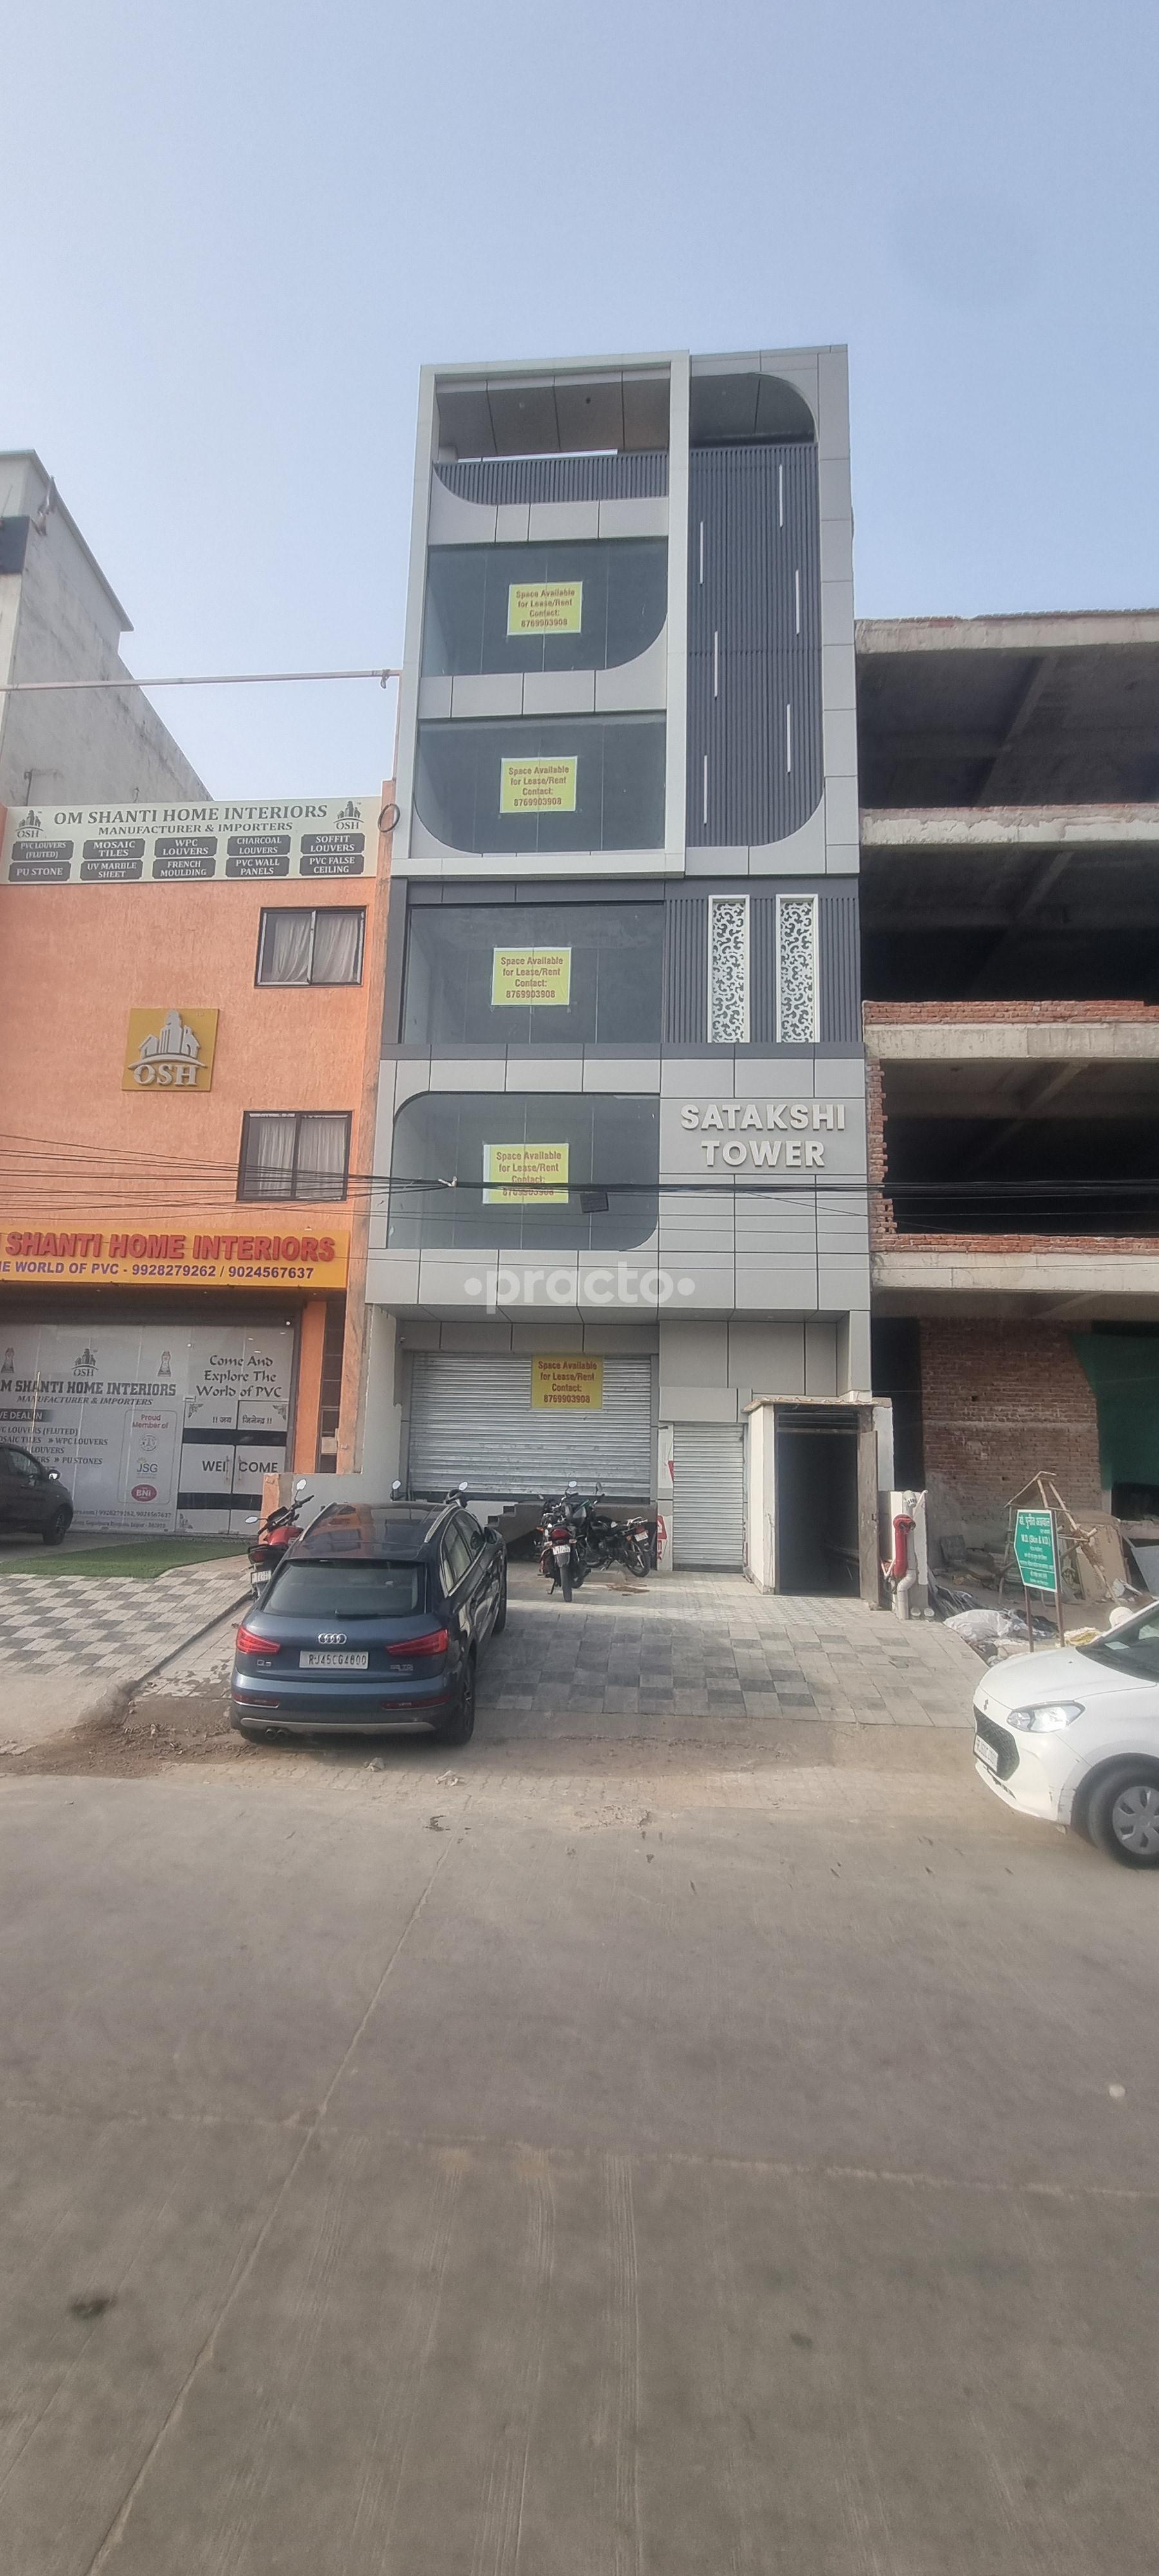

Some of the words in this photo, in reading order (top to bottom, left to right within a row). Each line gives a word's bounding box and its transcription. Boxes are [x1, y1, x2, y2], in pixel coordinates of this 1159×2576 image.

[516, 590, 539, 600] Space
[541, 589, 575, 598] Available
[531, 598, 572, 607] Lease/Rent
[509, 767, 532, 777] Space
[534, 766, 569, 774] Available
[523, 776, 567, 785] Lease/Rent
[54, 811, 83, 825] OM
[88, 809, 158, 824] SHANTI
[162, 808, 220, 822] HOME
[223, 804, 328, 820] INTERIORS
[98, 824, 202, 835] MANUFACTURER
[205, 823, 214, 833] &
[218, 822, 293, 832] IMPORTERS
[335, 821, 359, 830] OSH
[17, 830, 39, 838] OSH
[174, 838, 198, 847] WPC
[236, 837, 282, 845] CHARCOAL
[316, 835, 350, 844] SOFFIT
[93, 840, 136, 849] MOSAIC
[310, 844, 355, 853] LOUVERS
[26, 851, 59, 859] (FLUTED)
[98, 849, 129, 857] TILES
[162, 847, 209, 856] LOUVERS
[167, 860, 201, 869] FRENCH
[236, 858, 253, 867] PVC
[309, 857, 326, 866] PVC
[328, 856, 355, 864] FALSE
[101, 862, 137, 870] MARBLE
[313, 865, 350, 874] CEILING
[16, 868, 30, 876] PU
[31, 867, 63, 876] STONE
[98, 870, 126, 878] SHEET
[160, 868, 207, 877] MOULDING
[240, 867, 274, 876] PANELS
[500, 957, 525, 967] Space
[527, 956, 563, 965] Available
[502, 968, 514, 976] for
[516, 967, 560, 976] Lease/Rent
[514, 979, 547, 987] Contact:
[505, 990, 556, 998] 8769903908
[133, 1064, 199, 1086] OSH
[680, 1104, 847, 1130] SATAKSHI
[496, 1151, 522, 1162] Space
[524, 1151, 561, 1160] Available
[701, 1139, 825, 1168] TOWER
[498, 1164, 510, 1172] for
[513, 1163, 559, 1172] Lease/Rent
[5, 1231, 102, 1258] SHANTI
[108, 1233, 186, 1260] HOME
[193, 1235, 335, 1262] INTERIORS
[15, 1261, 64, 1273] WORLD
[69, 1263, 87, 1274] OF
[91, 1263, 119, 1274] PVC
[132, 1264, 216, 1277] 9928279262
[220, 1266, 225, 1277] /
[228, 1266, 314, 1279] 9024567637
[209, 1354, 244, 1367] Come
[247, 1355, 273, 1367] And
[538, 1361, 561, 1370] Space
[563, 1361, 598, 1370] Available
[73, 1368, 94, 1377] OSH
[204, 1370, 249, 1383] Explore
[253, 1370, 276, 1382] The
[552, 1372, 595, 1381] Lease/Rent
[15, 1380, 64, 1393] SHANTI
[67, 1381, 103, 1394] HOME
[106, 1382, 176, 1396] INTERIORS
[196, 1385, 236, 1397] World
[240, 1385, 253, 1397] of
[256, 1386, 282, 1398] PVC
[551, 1383, 582, 1392] Contact:
[100, 1397, 153, 1406] IMPORTERS
[543, 1394, 590, 1403] 8769903908
[42, 1427, 78, 1437] (FLUTED)
[74, 1437, 109, 1446] LOUVERS
[74, 1456, 103, 1465] STONES
[137, 1463, 158, 1473] JSG
